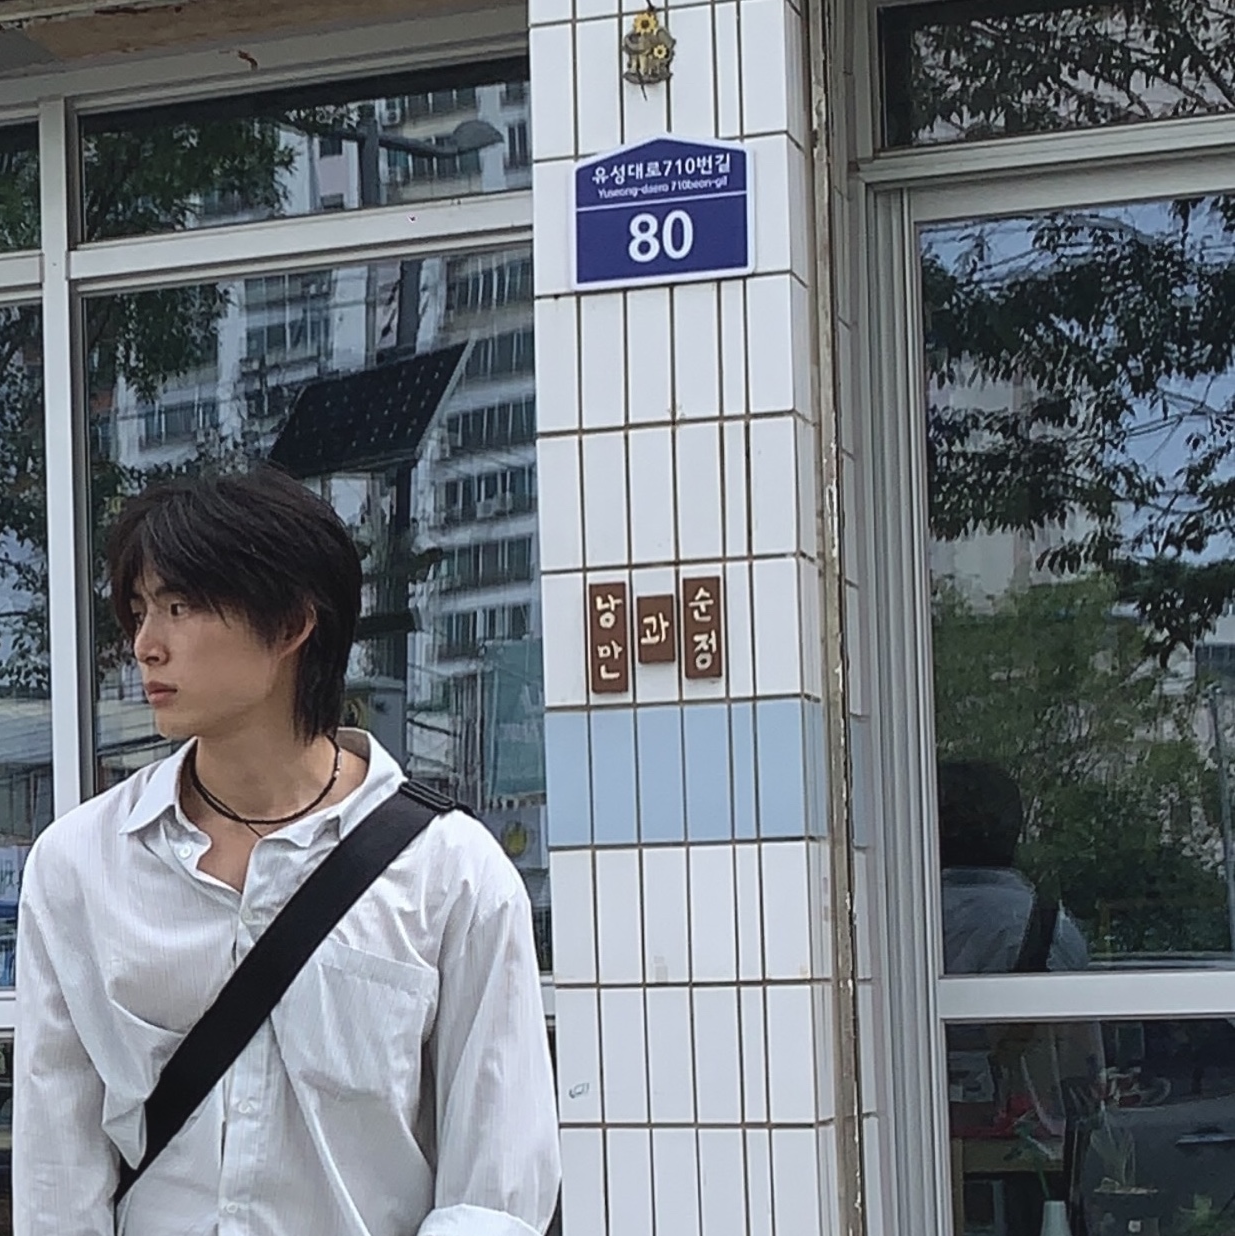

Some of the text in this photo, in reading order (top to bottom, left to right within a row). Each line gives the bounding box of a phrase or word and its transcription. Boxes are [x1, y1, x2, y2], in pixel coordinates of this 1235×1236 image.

[592, 153, 731, 186] 유성대로710번길
[628, 210, 694, 263] 80
[595, 594, 623, 680] 낭만
[688, 586, 717, 671] 순정
